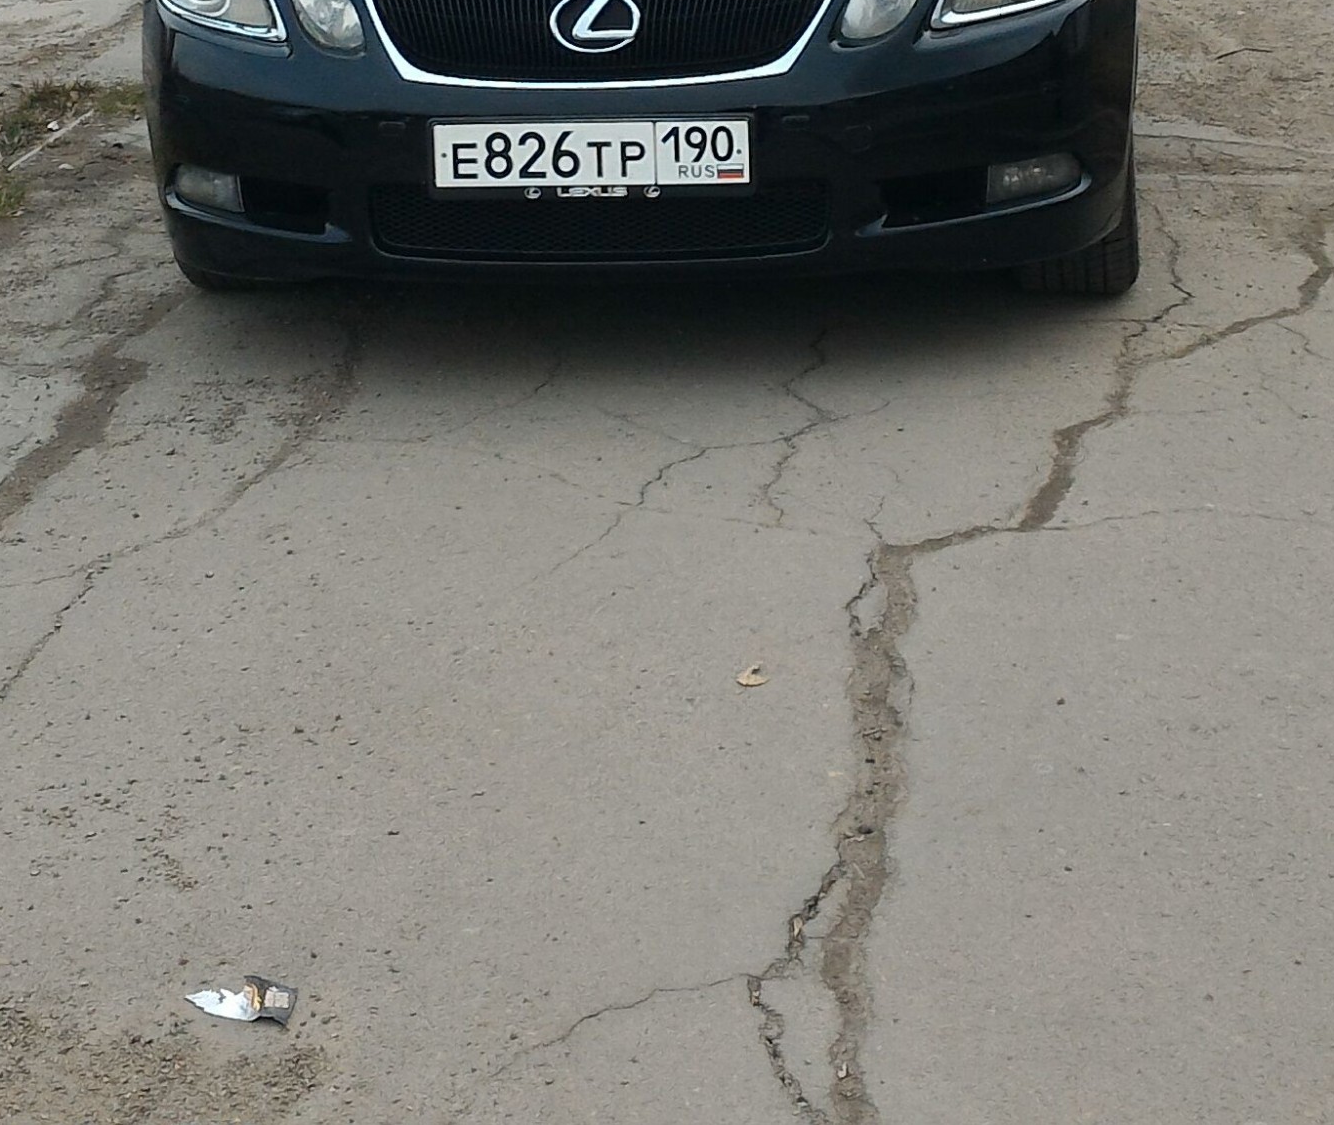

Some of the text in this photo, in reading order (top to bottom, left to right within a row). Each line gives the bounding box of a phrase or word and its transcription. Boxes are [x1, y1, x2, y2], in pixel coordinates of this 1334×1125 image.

[451, 125, 734, 180] Е826ТР 190
[678, 164, 715, 179] RUS
[556, 186, 629, 198] LEXUS
